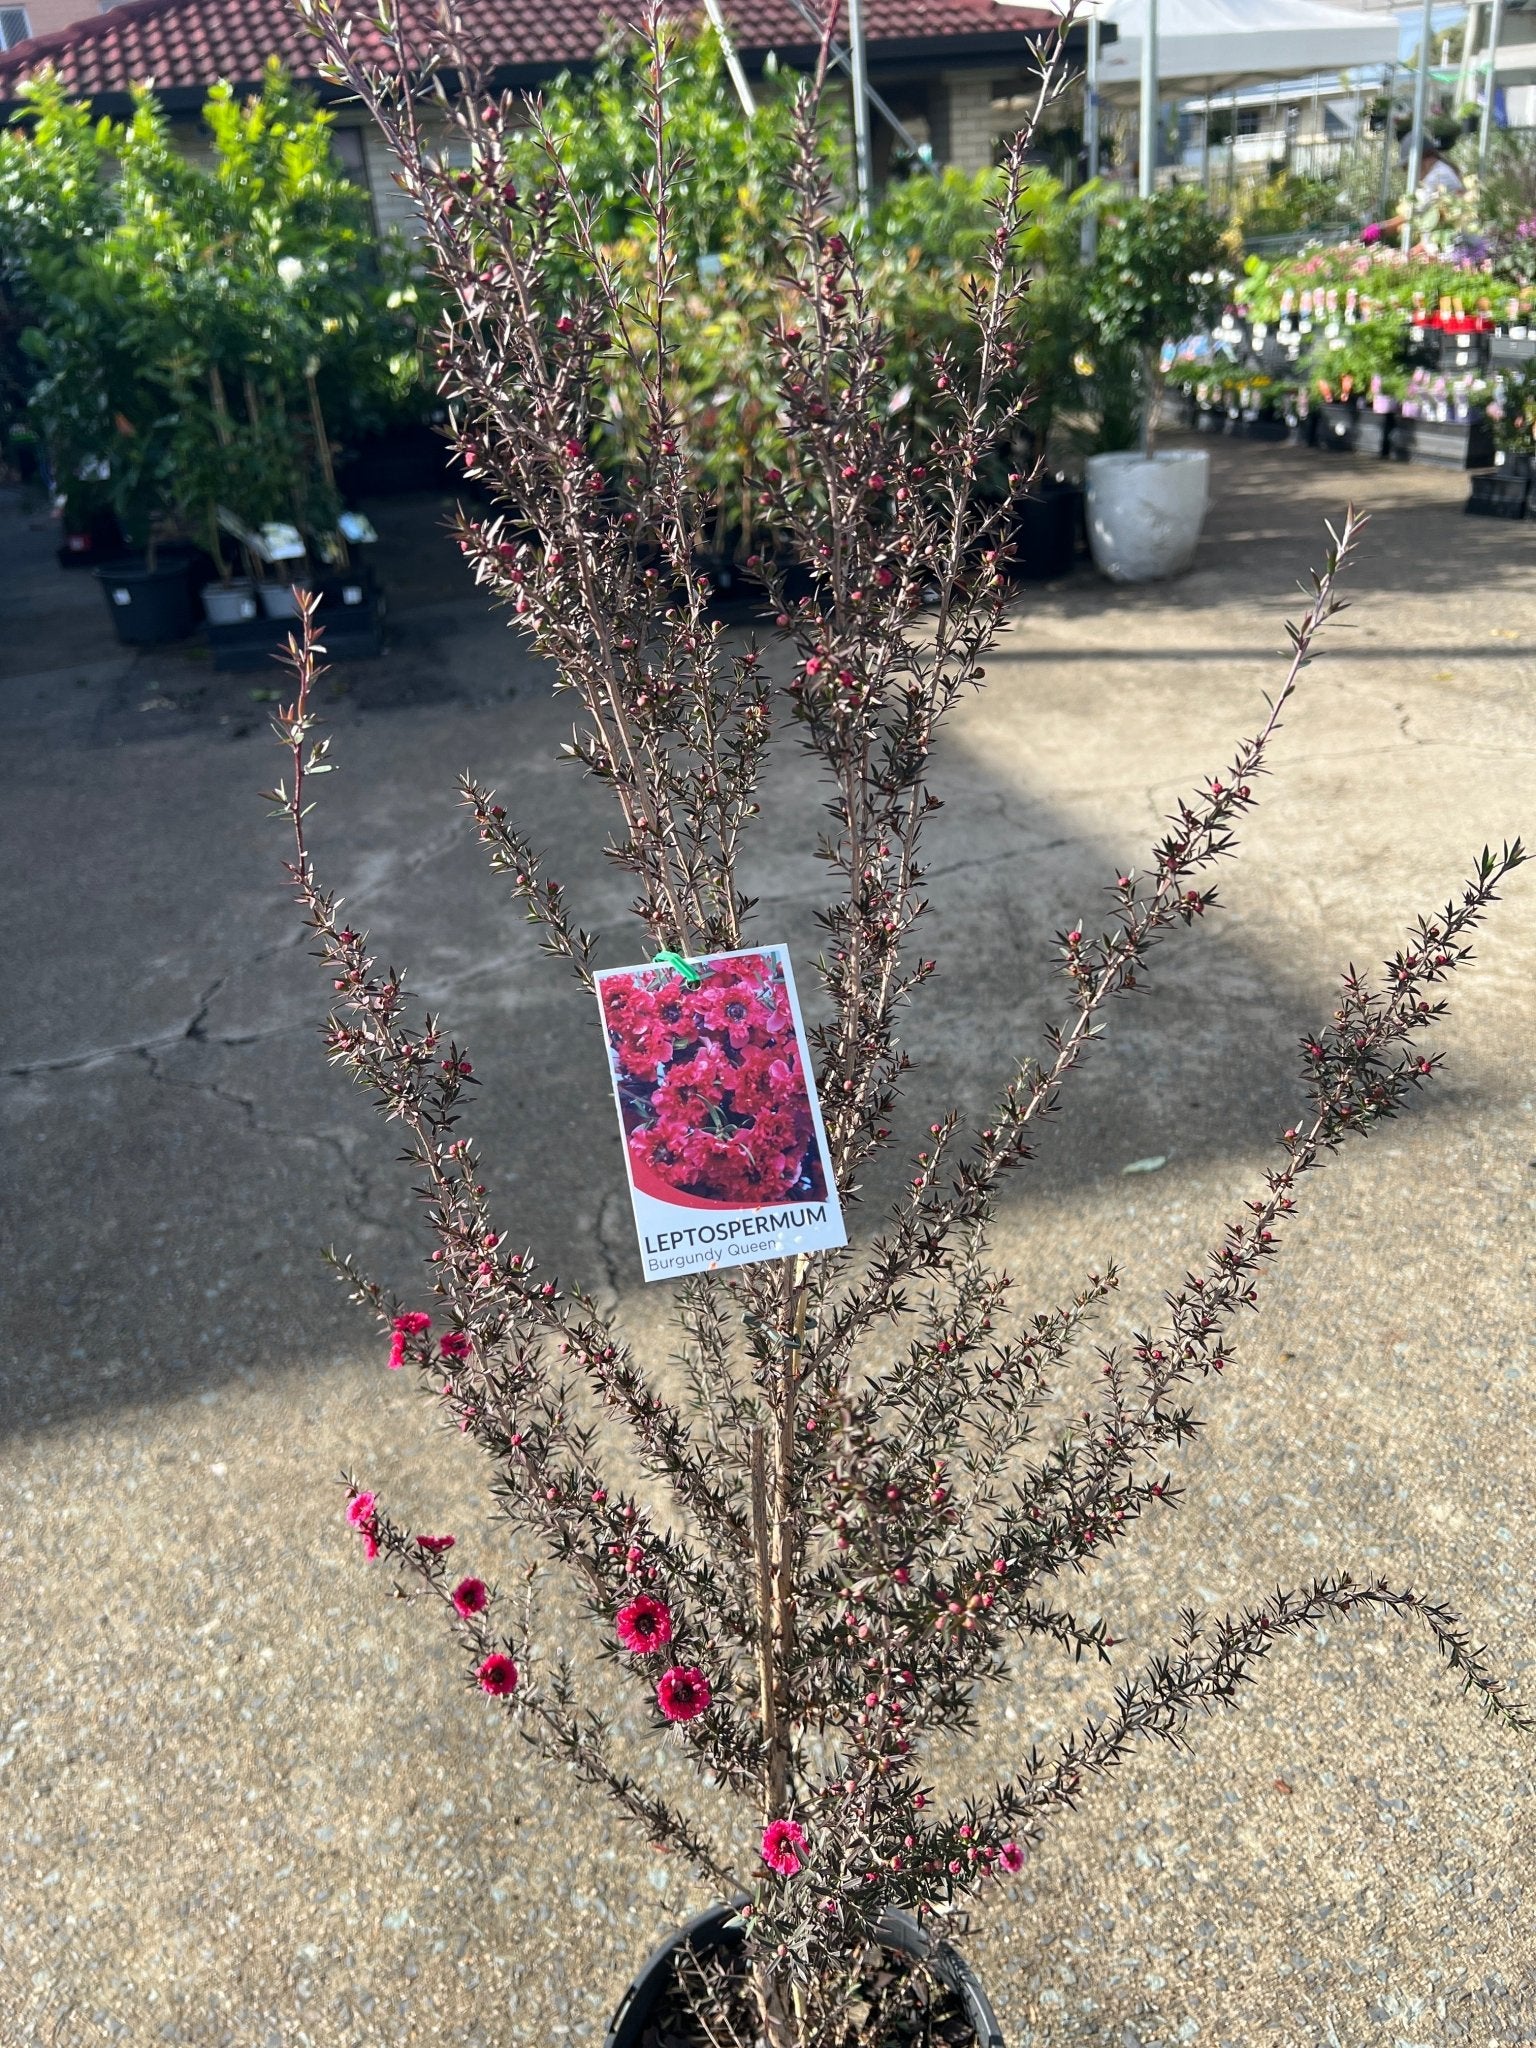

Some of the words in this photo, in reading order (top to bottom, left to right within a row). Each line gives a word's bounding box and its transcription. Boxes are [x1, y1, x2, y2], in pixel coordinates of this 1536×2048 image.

[645, 1206, 827, 1254] LEPTOSPERMUM
[648, 1247, 723, 1272] Burgundy
[728, 1238, 777, 1256] Queen
